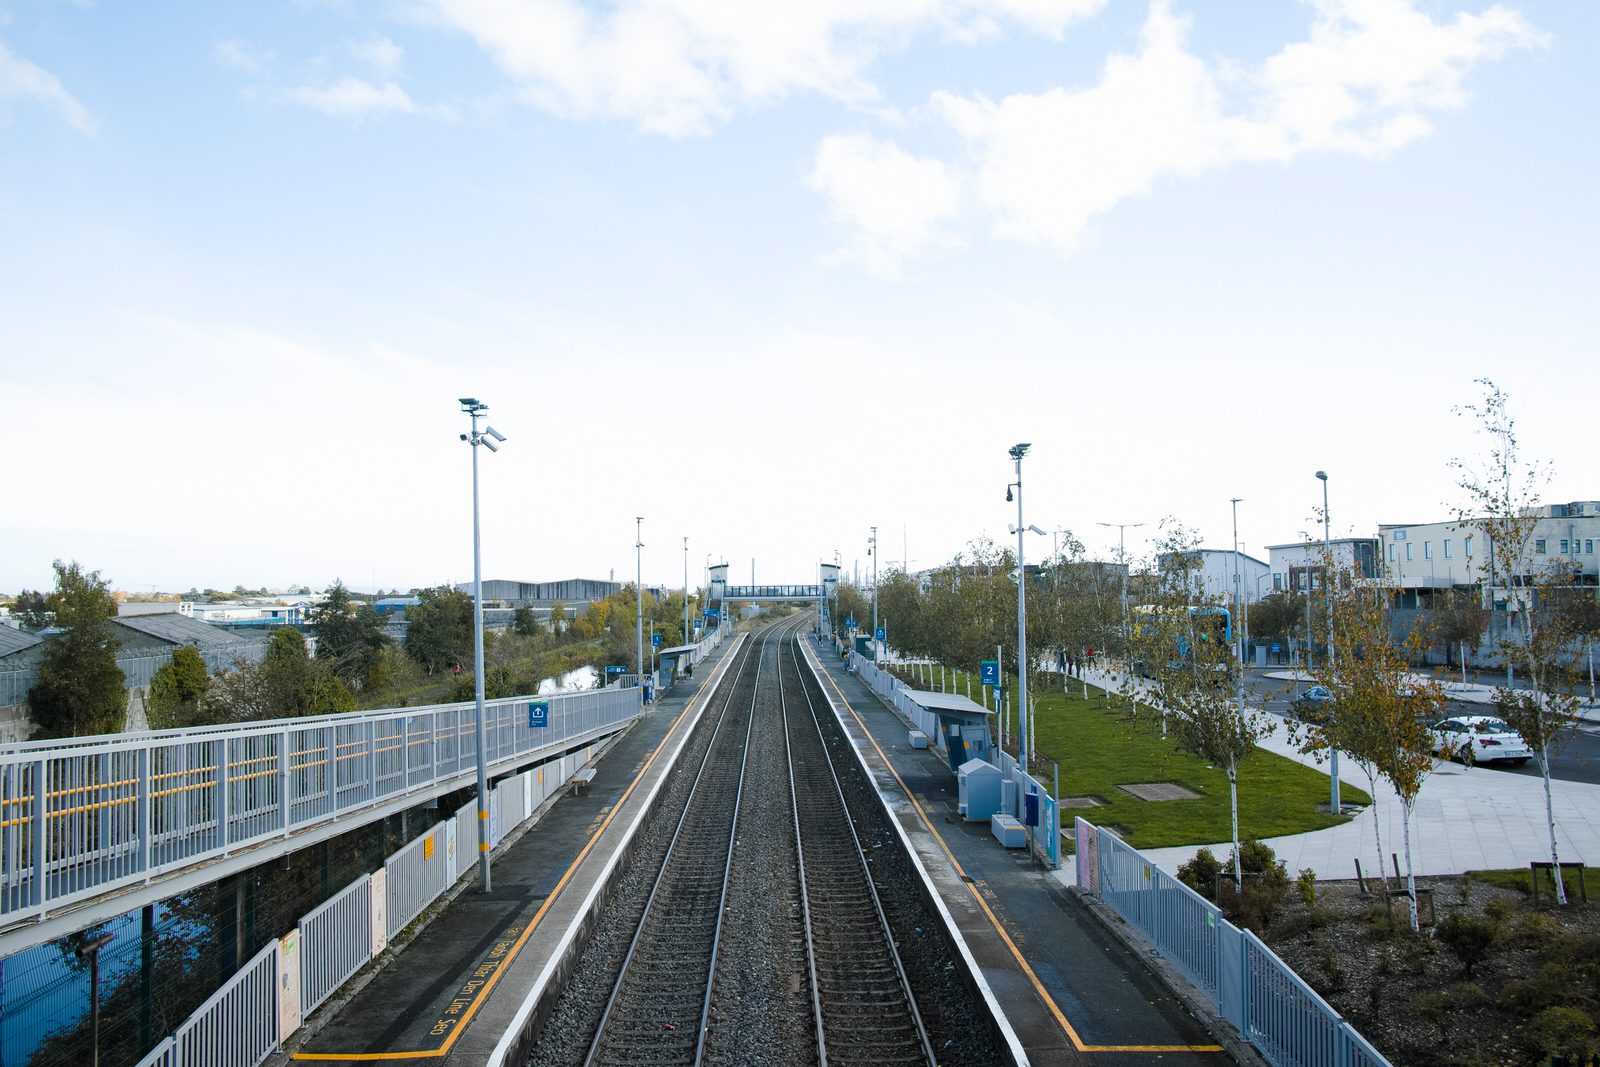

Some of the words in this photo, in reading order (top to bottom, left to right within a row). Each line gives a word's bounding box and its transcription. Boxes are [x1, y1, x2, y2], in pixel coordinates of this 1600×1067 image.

[986, 666, 993, 675] 2
[473, 961, 500, 978] Thiar
[460, 980, 485, 995] Den
[430, 1019, 457, 1036] Seo
